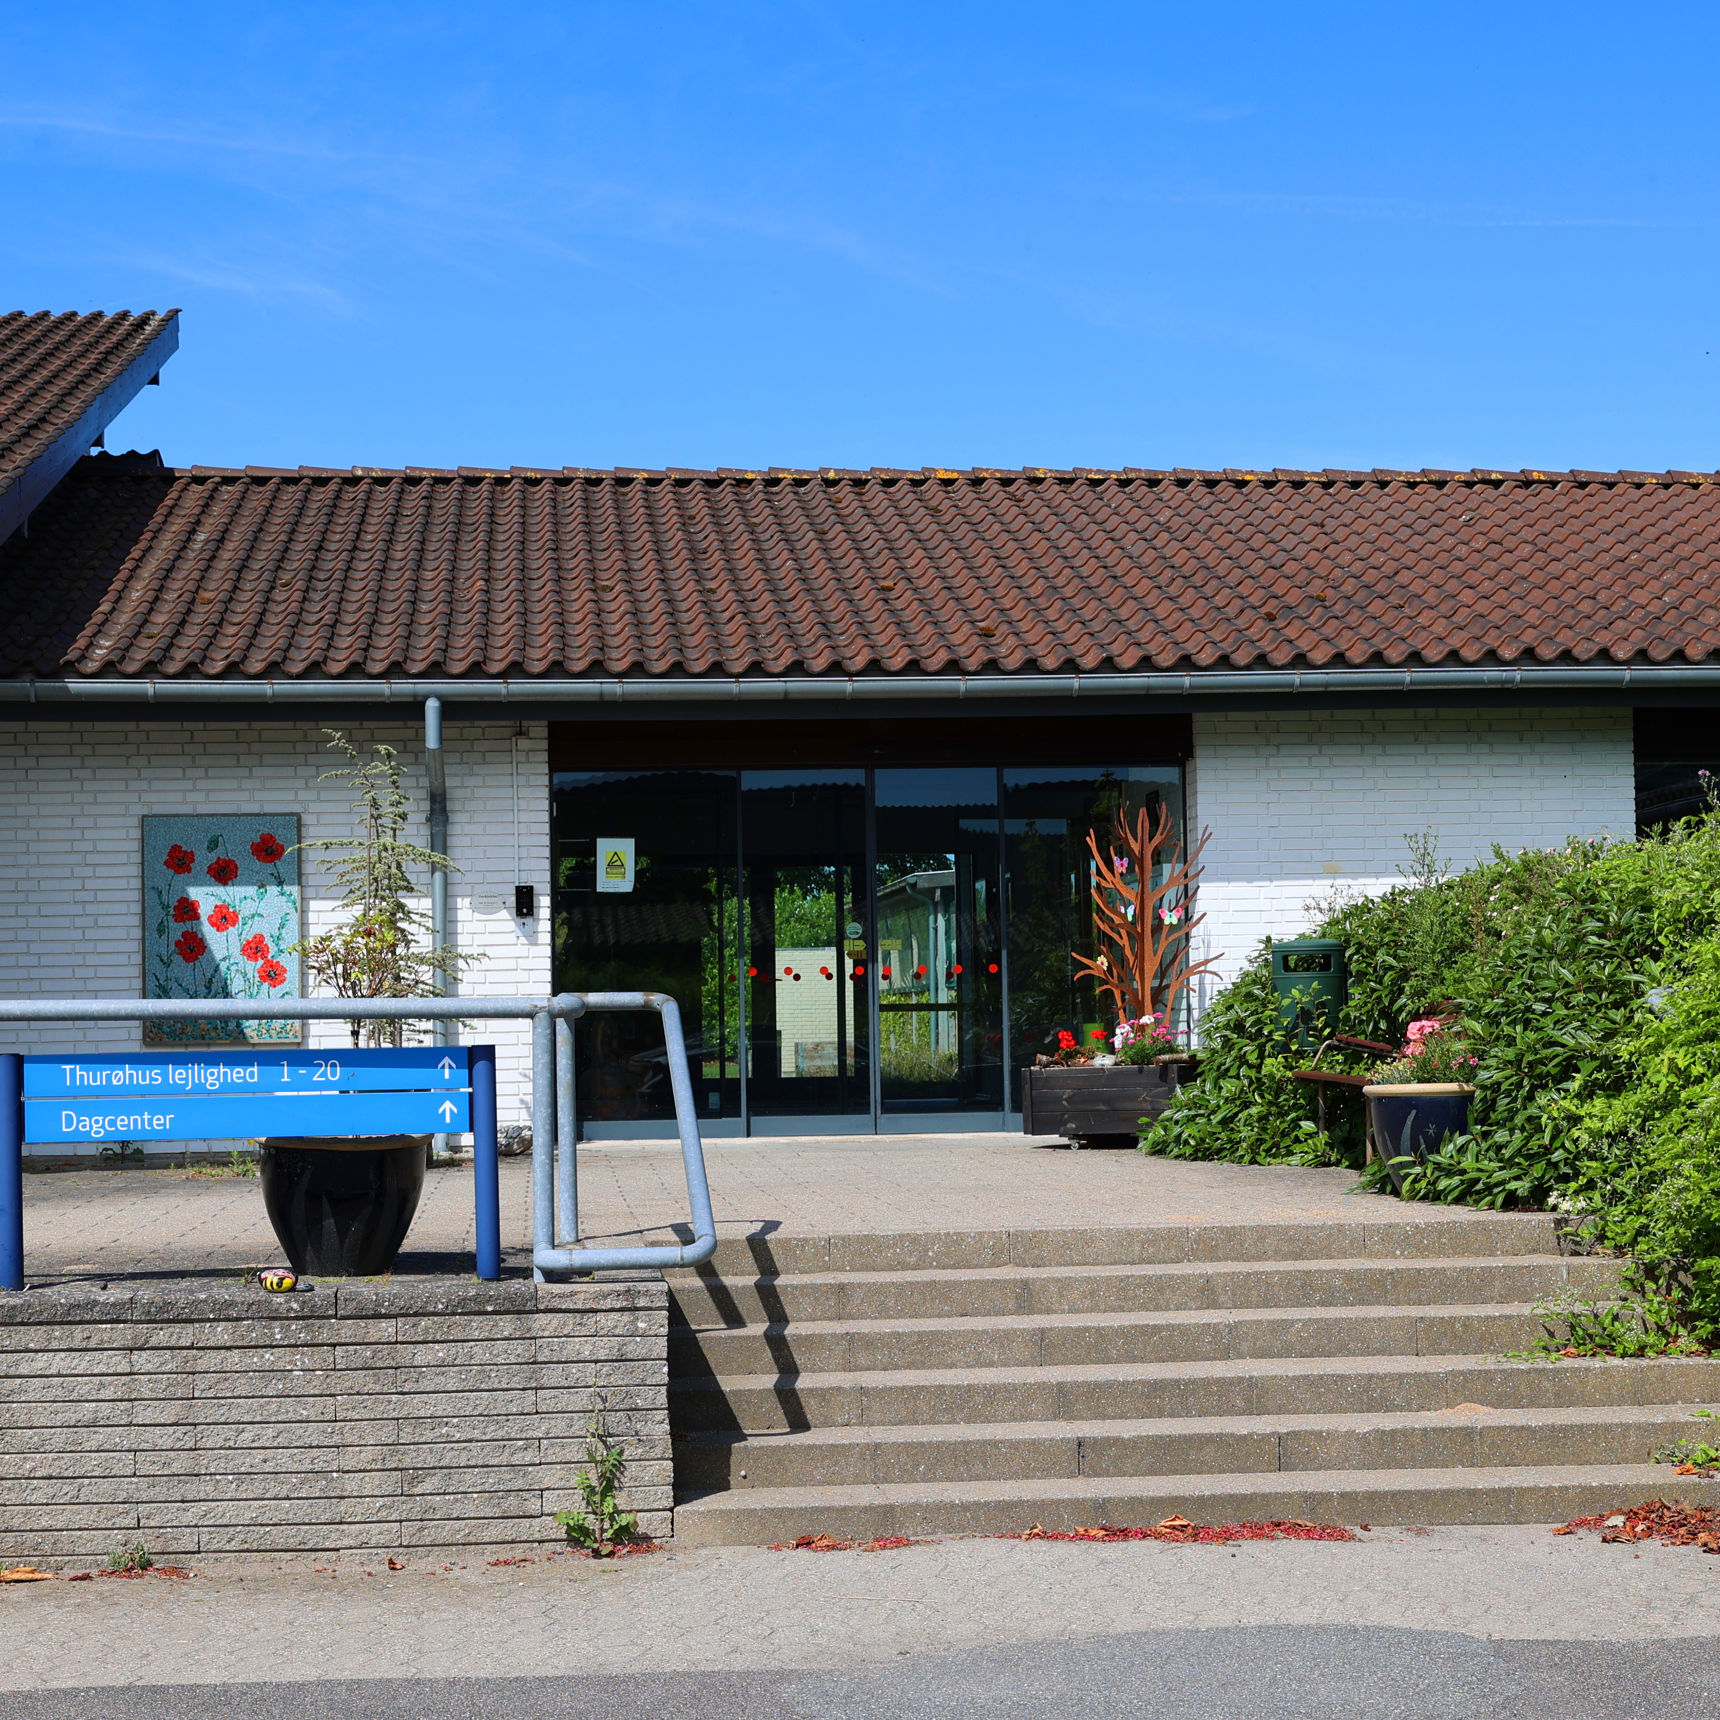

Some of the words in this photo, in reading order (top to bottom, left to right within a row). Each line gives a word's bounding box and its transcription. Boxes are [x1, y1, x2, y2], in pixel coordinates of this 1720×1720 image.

[61, 1064, 162, 1087] Thurøhus
[168, 1062, 258, 1091] lejlighed
[280, 1060, 291, 1082] 1
[312, 1059, 341, 1081] 20
[61, 1110, 175, 1138] Dagcenter
